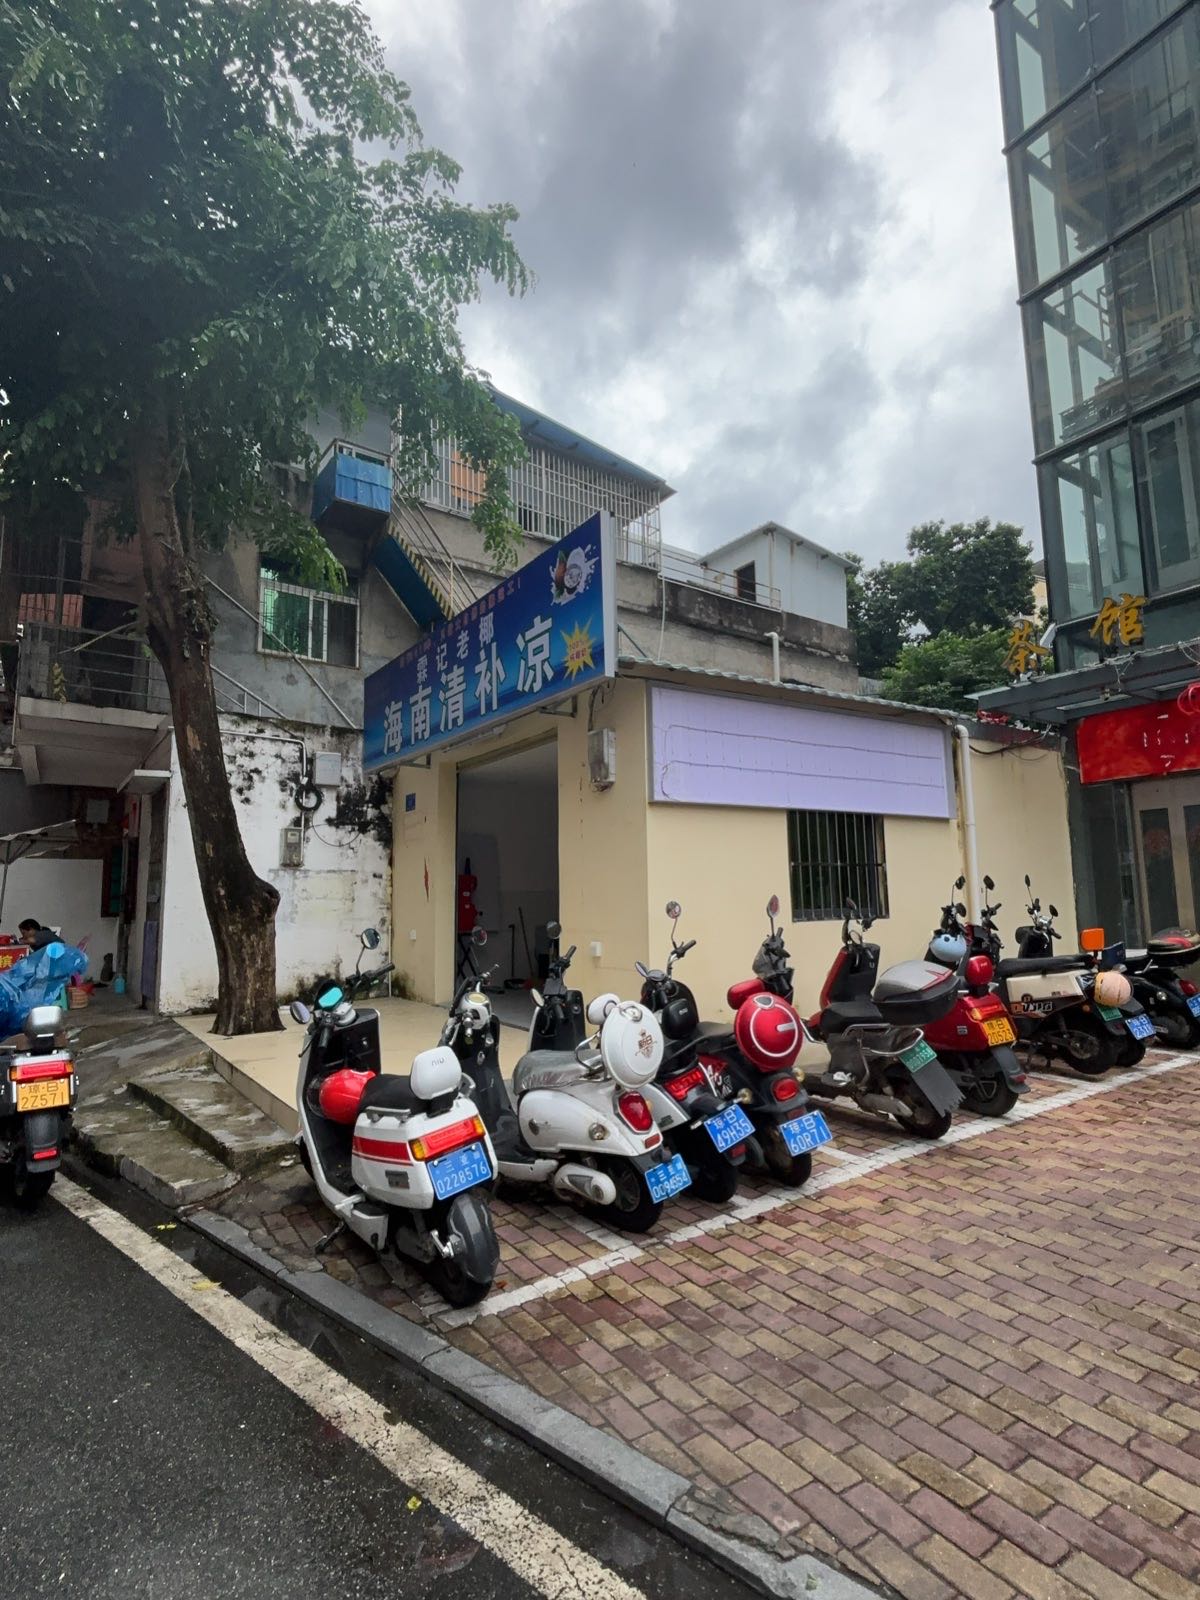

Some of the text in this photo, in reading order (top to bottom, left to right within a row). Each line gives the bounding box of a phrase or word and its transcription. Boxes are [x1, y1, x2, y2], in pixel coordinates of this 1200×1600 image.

[1001, 593, 1149, 674] 茶馆
[383, 615, 553, 755] 海南清补凉
[988, 1029, 1013, 1044] 20523
[21, 1091, 64, 1109] 2Z571
[716, 1119, 751, 1149] 49H35
[790, 1127, 827, 1153] 60R71
[436, 1160, 487, 1194] 0228576
